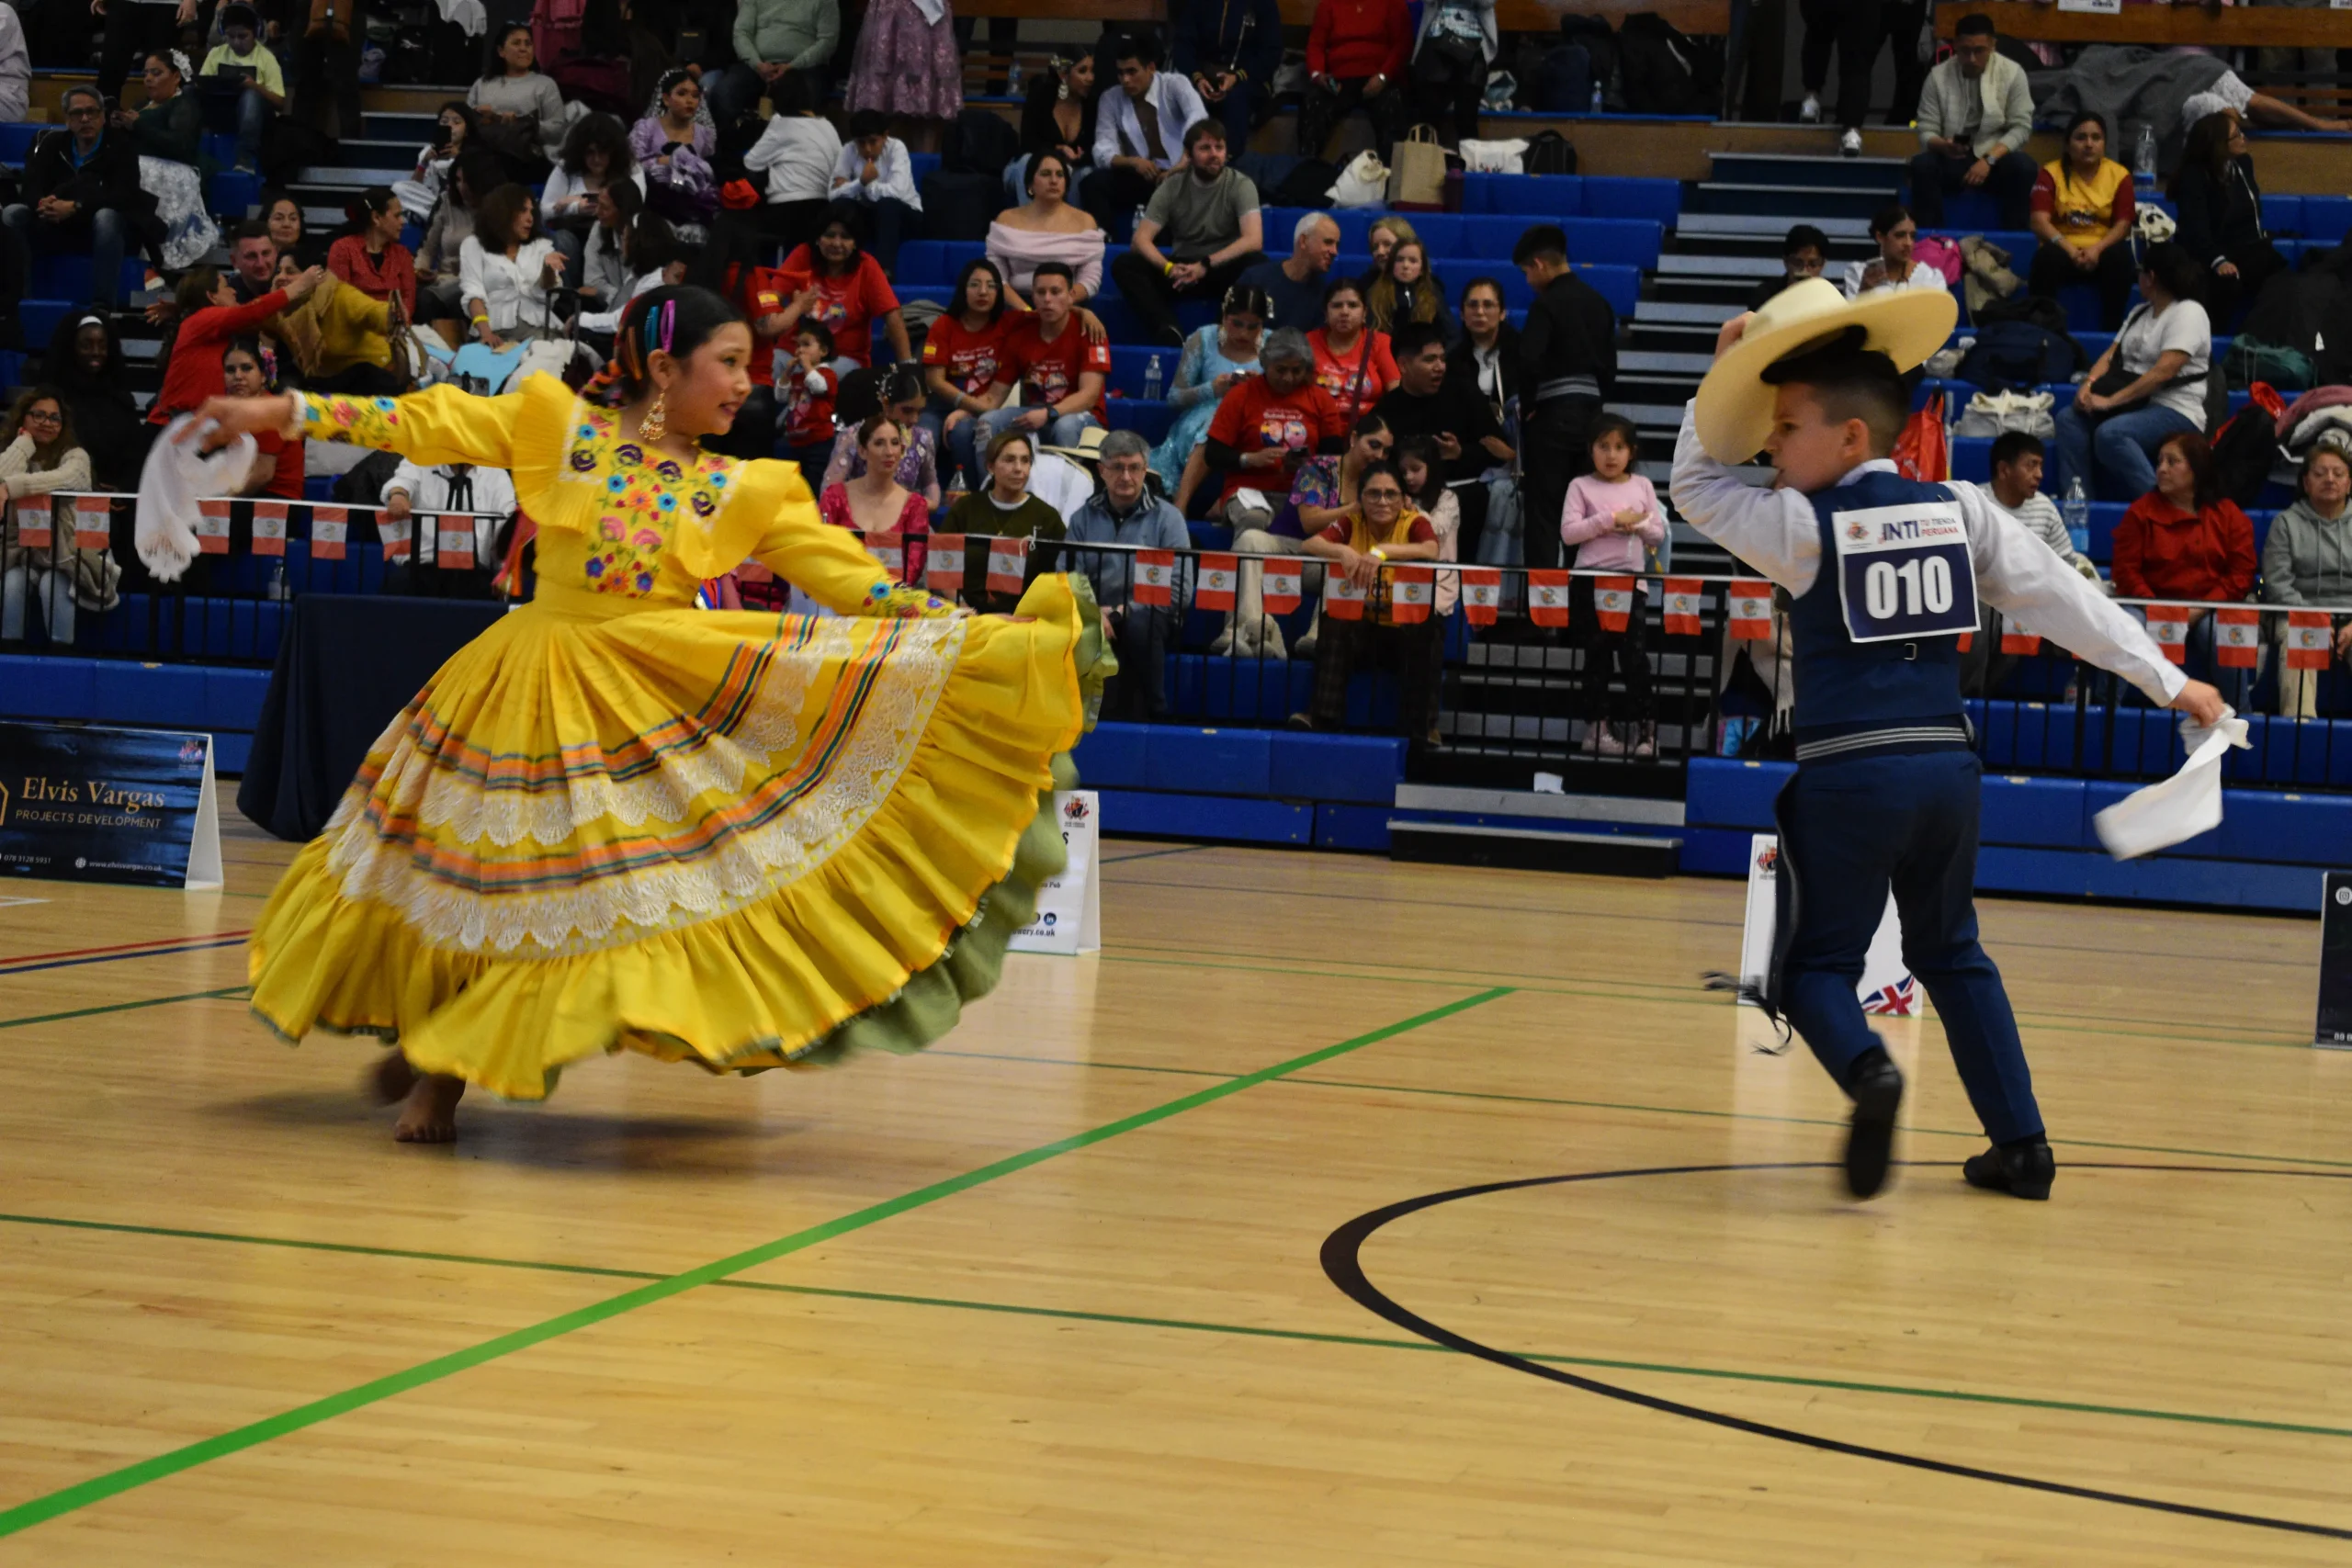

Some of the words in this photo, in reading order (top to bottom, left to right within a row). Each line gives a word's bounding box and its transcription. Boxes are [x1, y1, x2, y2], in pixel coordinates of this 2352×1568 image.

[1865, 555, 1953, 619] 010
[21, 776, 79, 802] Elvis
[87, 782, 165, 815] Vargas
[16, 809, 74, 823] PROJECTS
[77, 814, 162, 829] DEVELOPMENT
